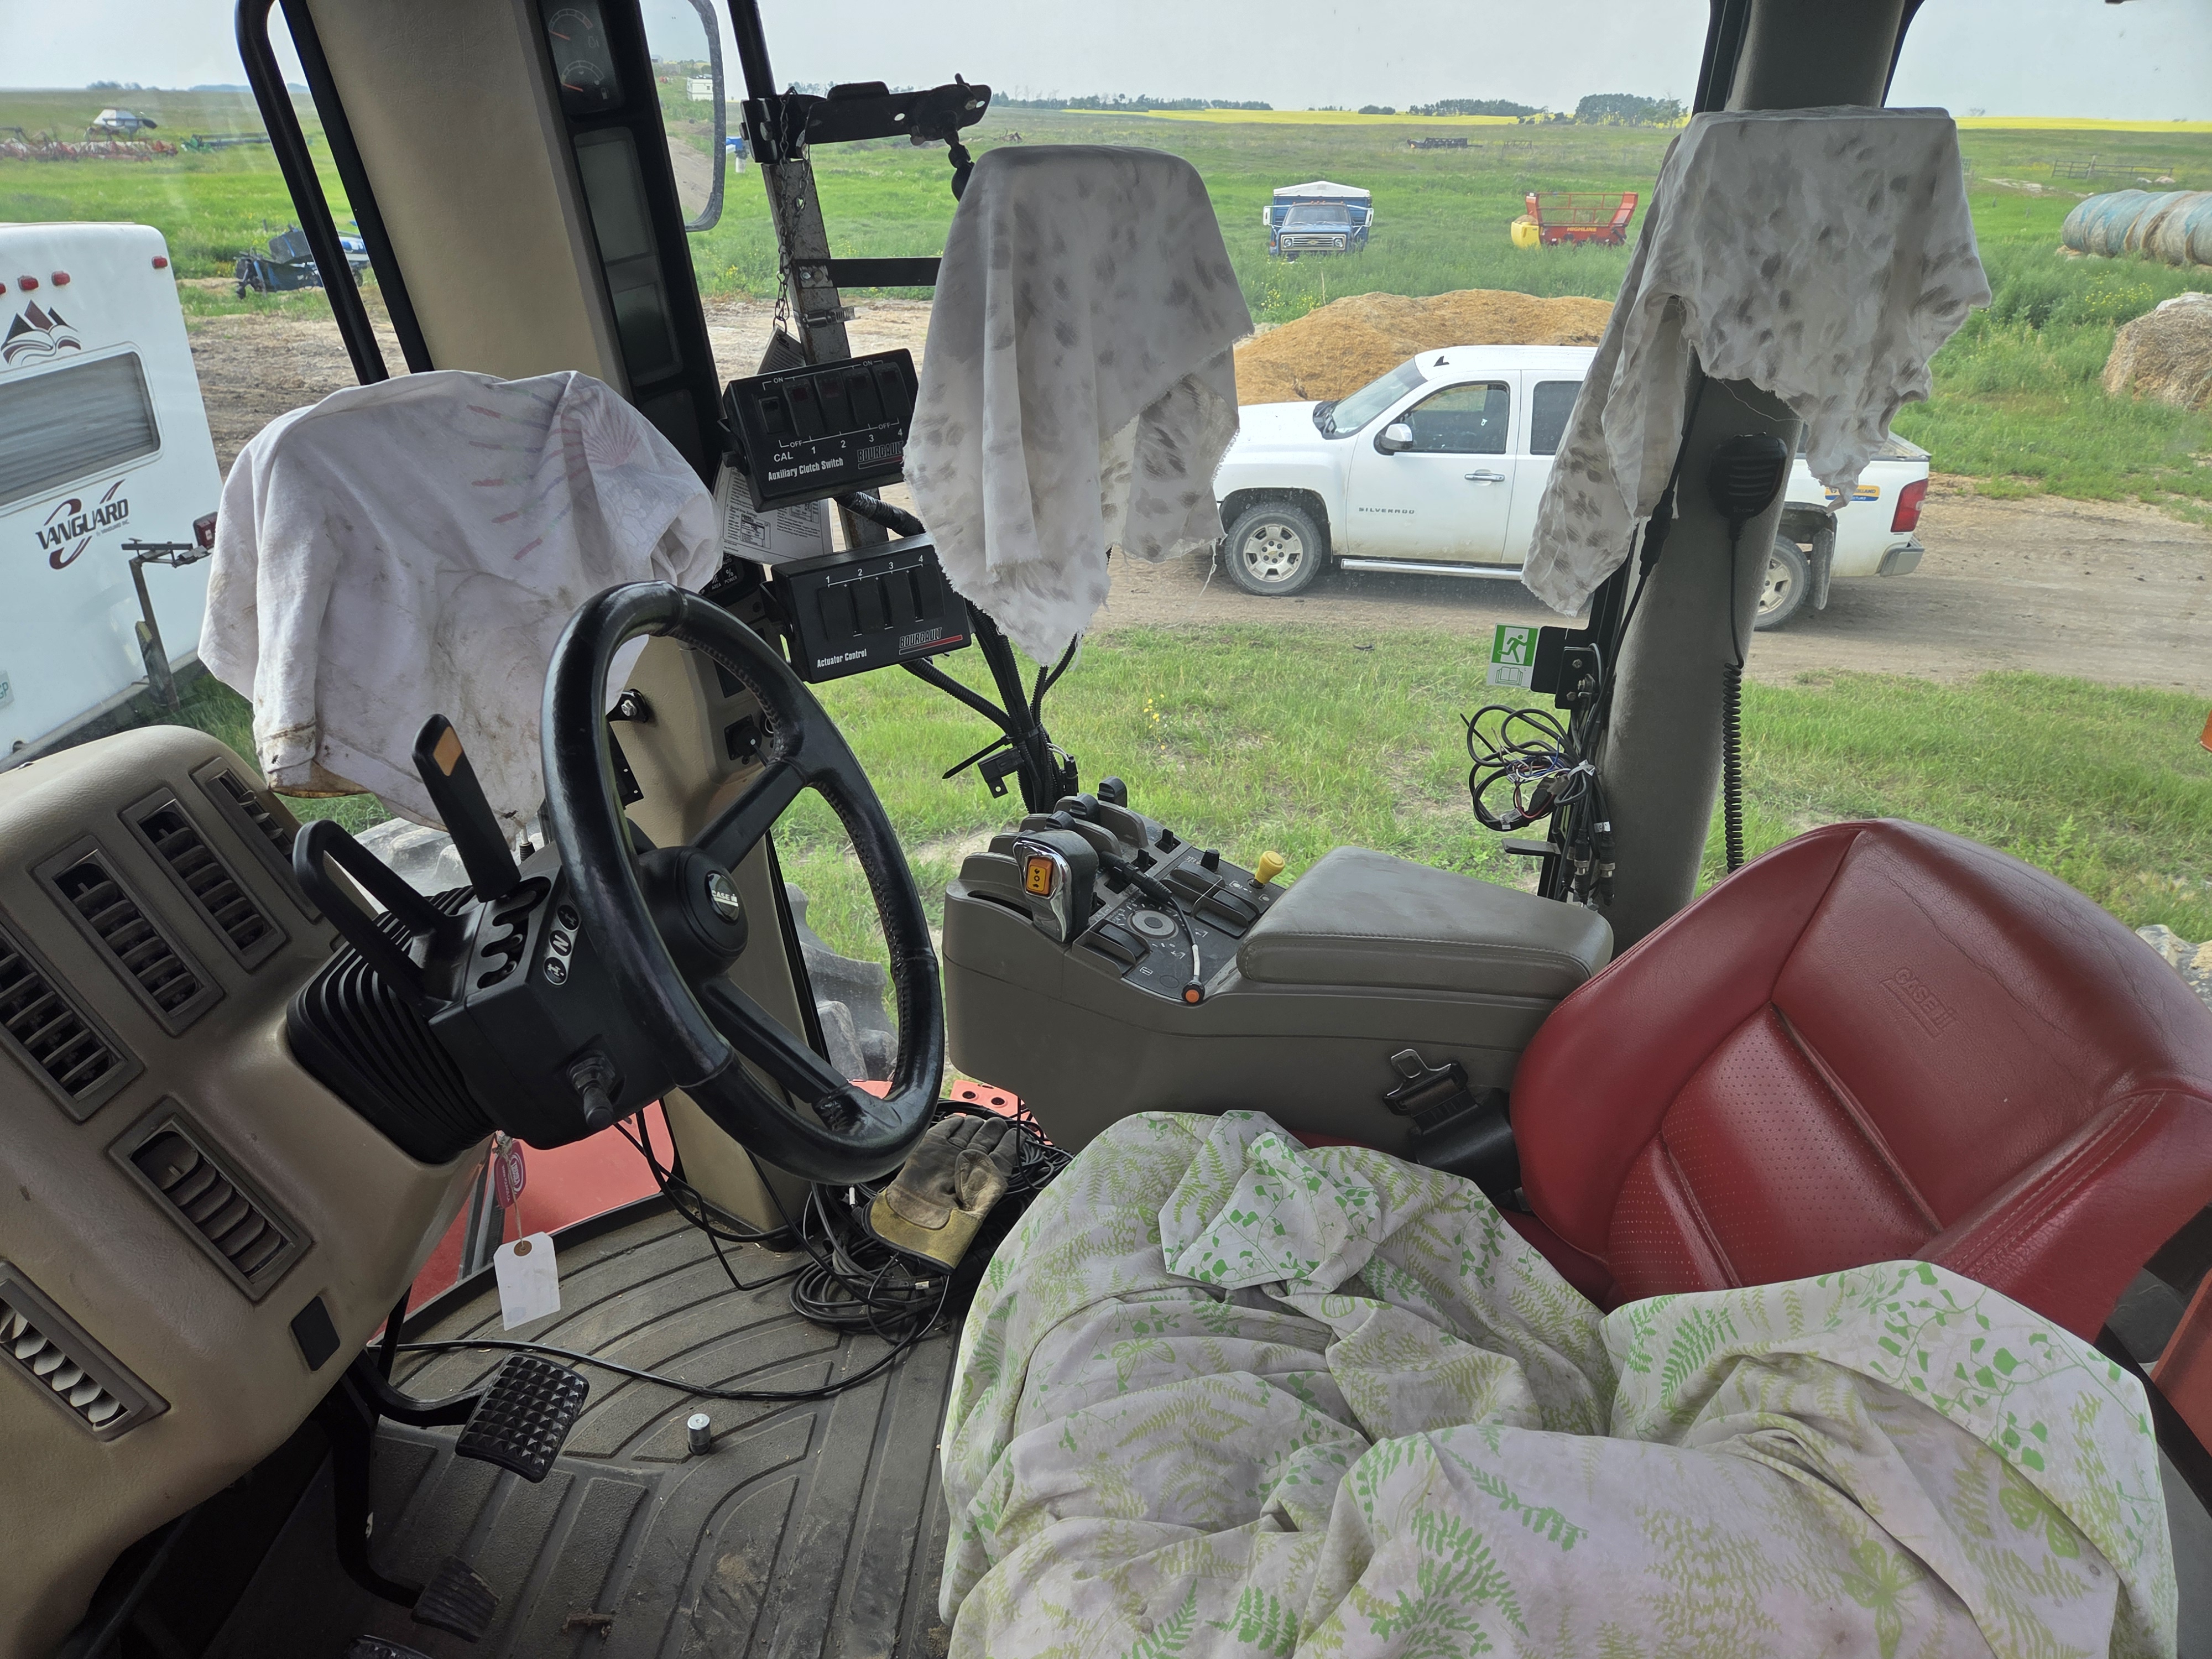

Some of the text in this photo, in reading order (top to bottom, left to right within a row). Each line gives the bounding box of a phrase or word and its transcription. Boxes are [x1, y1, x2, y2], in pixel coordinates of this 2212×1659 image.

[774, 452, 794, 462] CAL
[811, 446, 816, 454] 1
[897, 428, 903, 436] 4
[857, 441, 904, 462] BOURGAULT
[768, 457, 844, 481] Auxiliary Clutch Switch
[35, 498, 129, 550] VANGUARD
[724, 575, 738, 584] POWER
[899, 627, 942, 648] BOURGAULT
[817, 648, 867, 668] Actuator Control
[712, 890, 730, 900] CASE
[553, 934, 569, 953] N
[1893, 968, 1937, 1012] CASE
